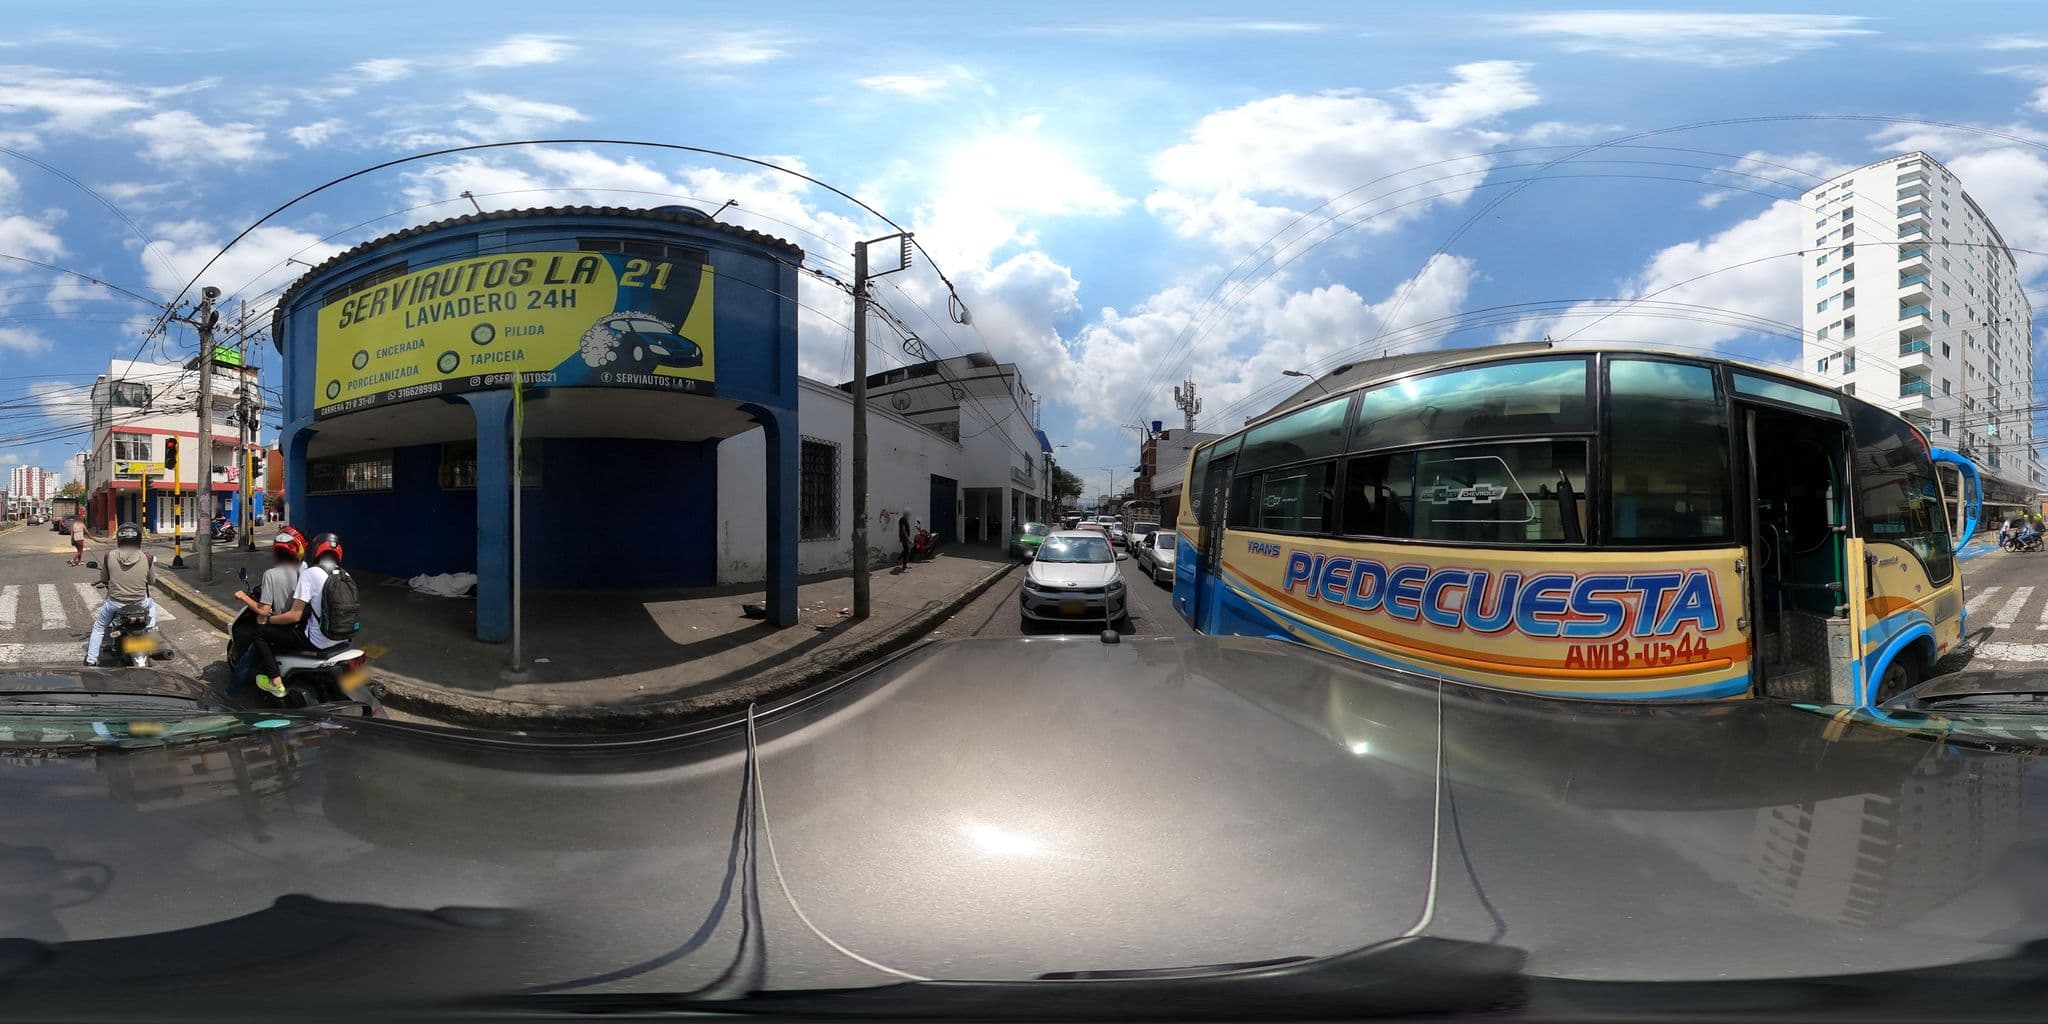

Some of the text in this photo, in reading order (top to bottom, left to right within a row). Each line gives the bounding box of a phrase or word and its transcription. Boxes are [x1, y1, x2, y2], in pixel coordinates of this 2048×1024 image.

[339, 256, 673, 329] SERVIAUTOS LA 21
[405, 289, 576, 329] LAVADERO 24H
[504, 325, 545, 337] PILIDA
[376, 338, 425, 359] ENCERADA
[347, 365, 419, 390] PORCELANIZADA
[484, 372, 557, 386] @SERVAUTOS21
[616, 373, 670, 387] SERVIAUTOS
[1247, 541, 1281, 558] TRANS
[1284, 550, 1720, 638] PIEDECUESTA
[1564, 632, 1709, 669] AMB-0544
